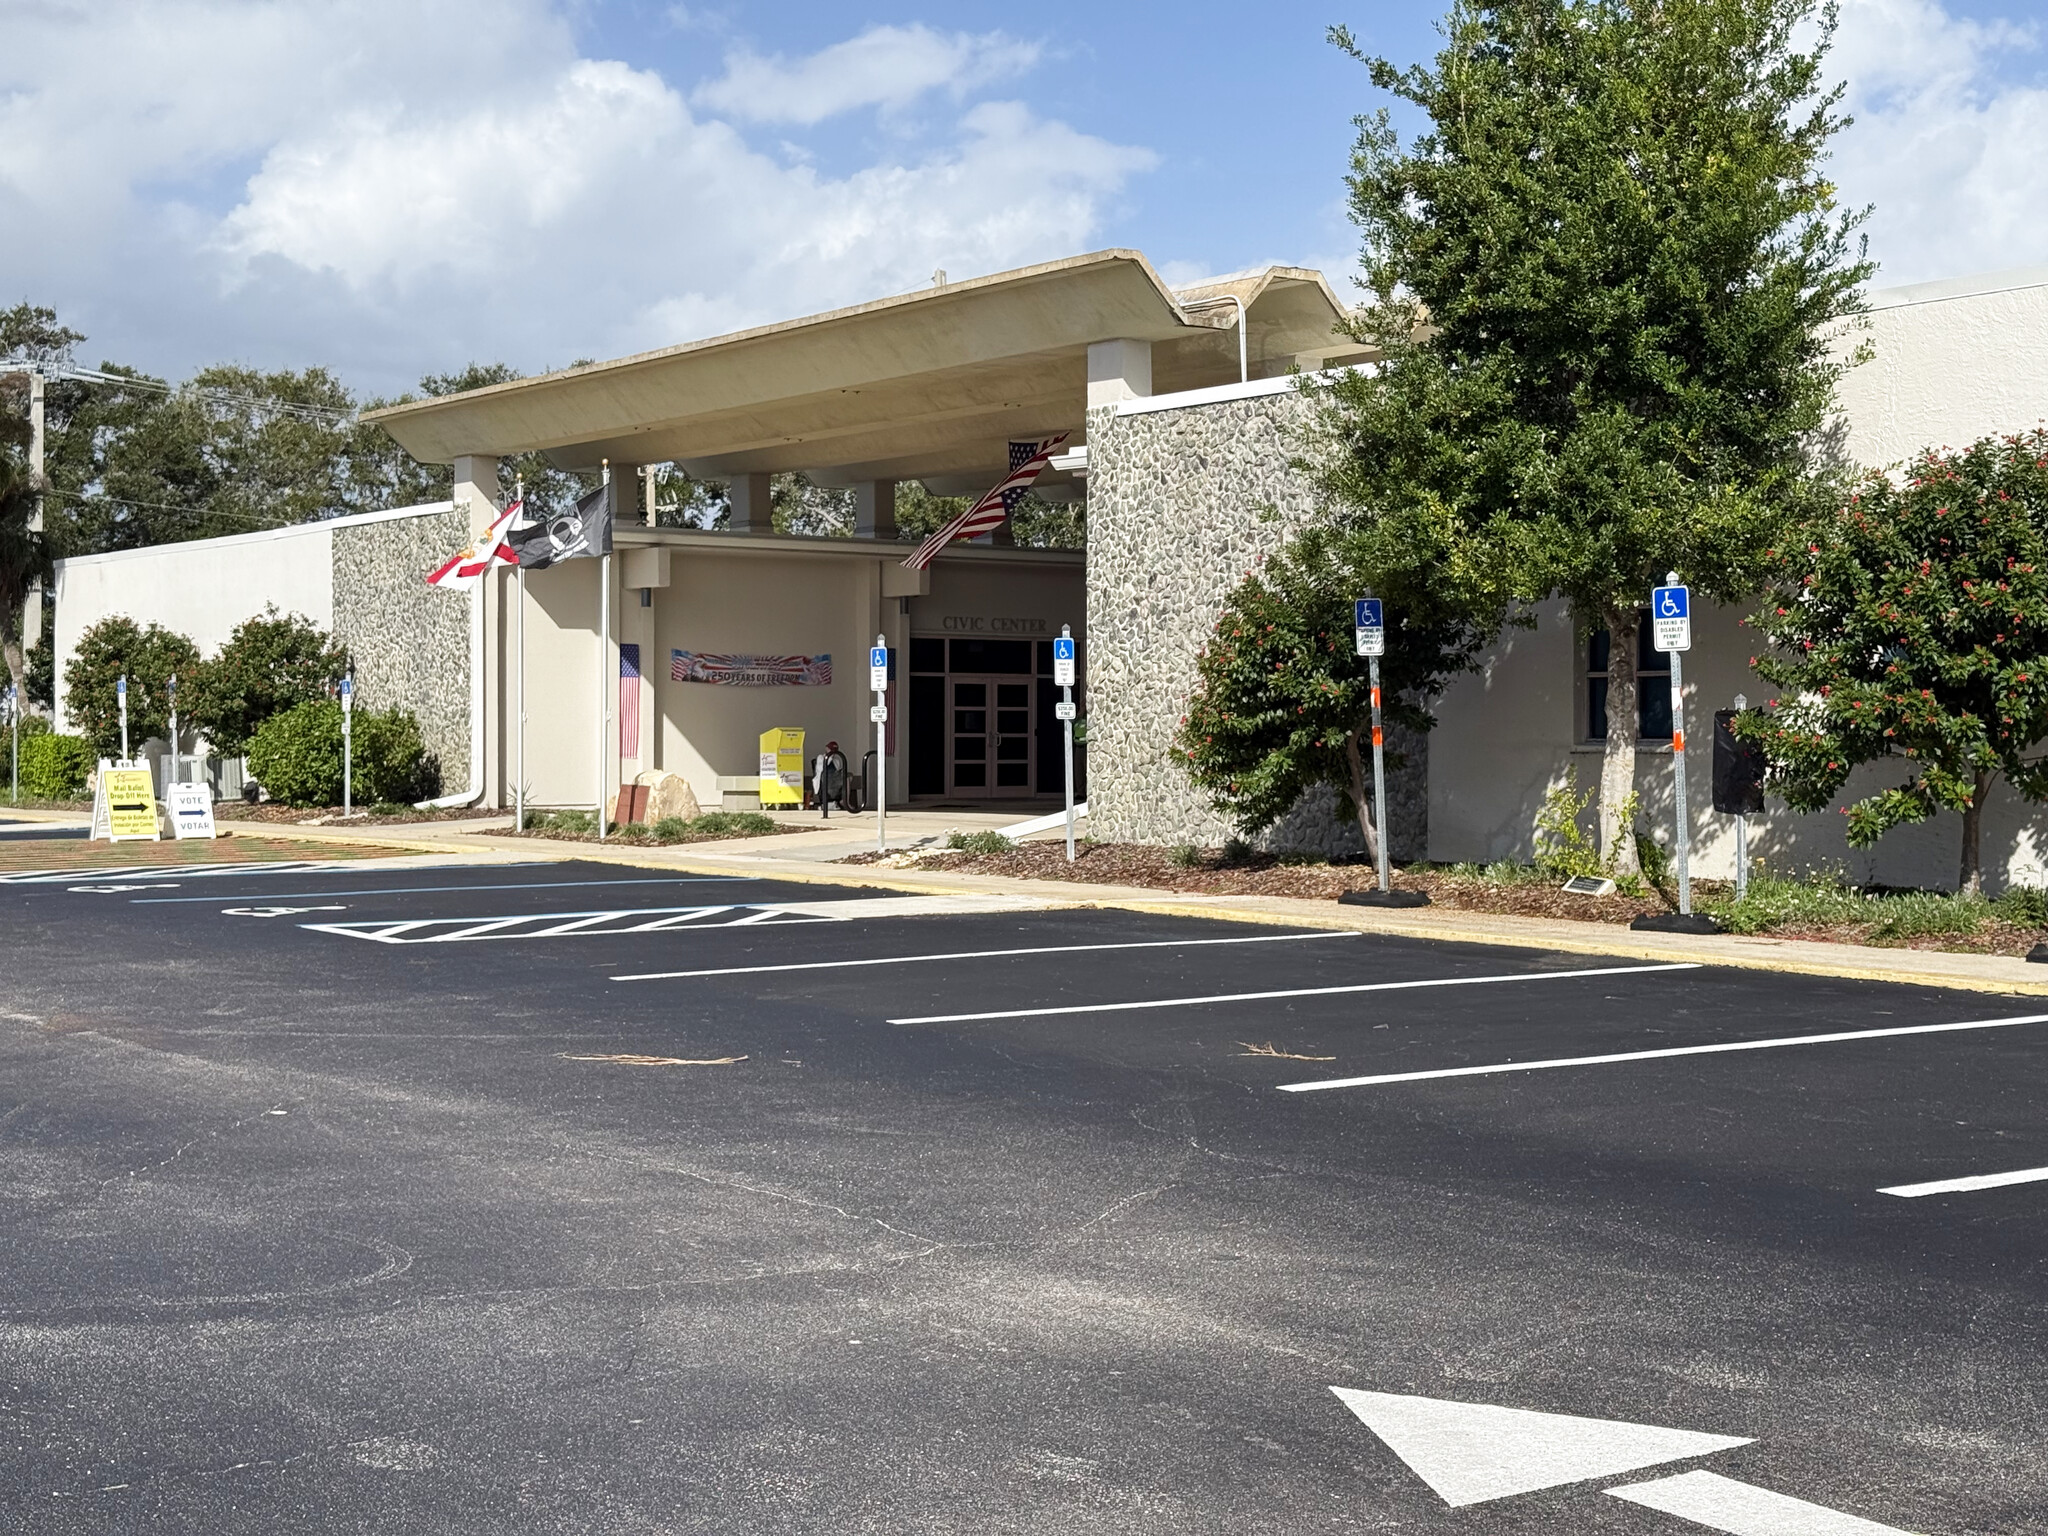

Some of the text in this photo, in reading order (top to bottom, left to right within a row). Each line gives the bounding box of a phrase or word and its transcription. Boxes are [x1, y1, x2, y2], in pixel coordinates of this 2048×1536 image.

[943, 616, 1047, 632] CIVIC CENTER
[712, 671, 801, 682] 250 YEARS OF FREEDOM
[180, 797, 203, 805] VOTE
[180, 822, 210, 830] VOTAR
